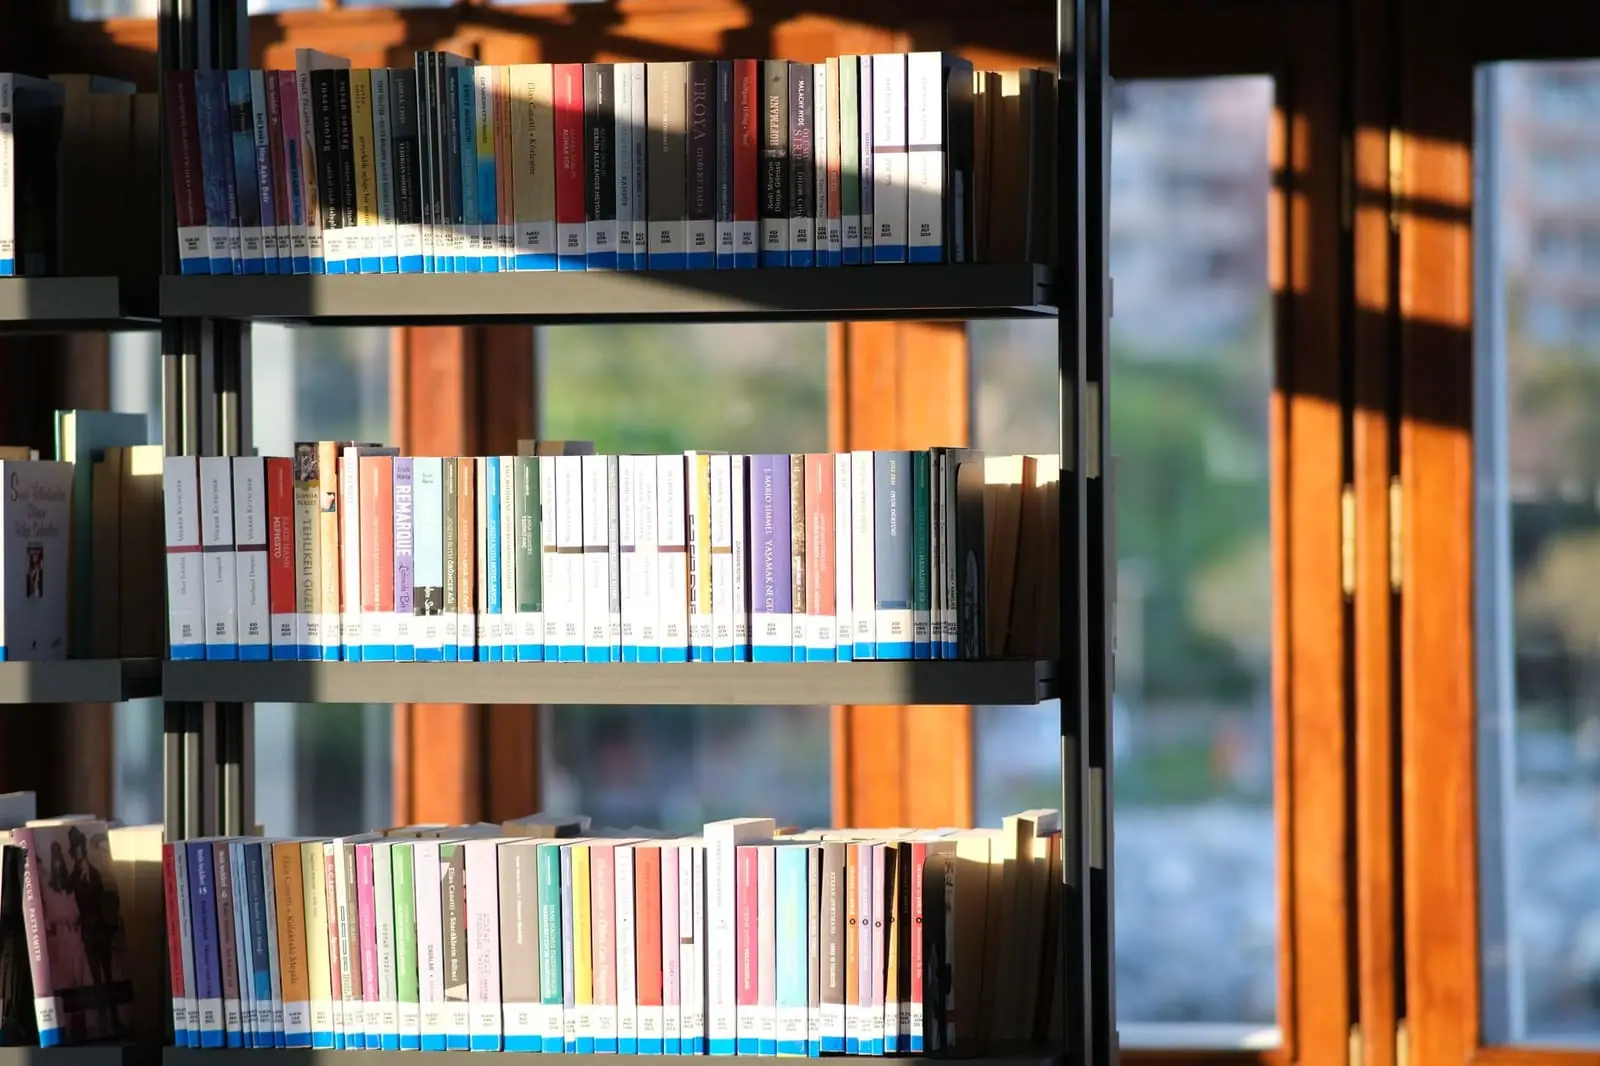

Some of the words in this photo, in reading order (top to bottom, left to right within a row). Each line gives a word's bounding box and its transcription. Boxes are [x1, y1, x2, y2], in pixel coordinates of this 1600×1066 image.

[694, 78, 706, 140] TROYA
[769, 95, 779, 146] HOFFMANN
[764, 475, 772, 502] MARIO
[273, 516, 282, 558] MEPHISTO
[396, 485, 412, 556] REMARQUE
[764, 504, 772, 534] SIMMEL
[448, 867, 456, 884] Elias
